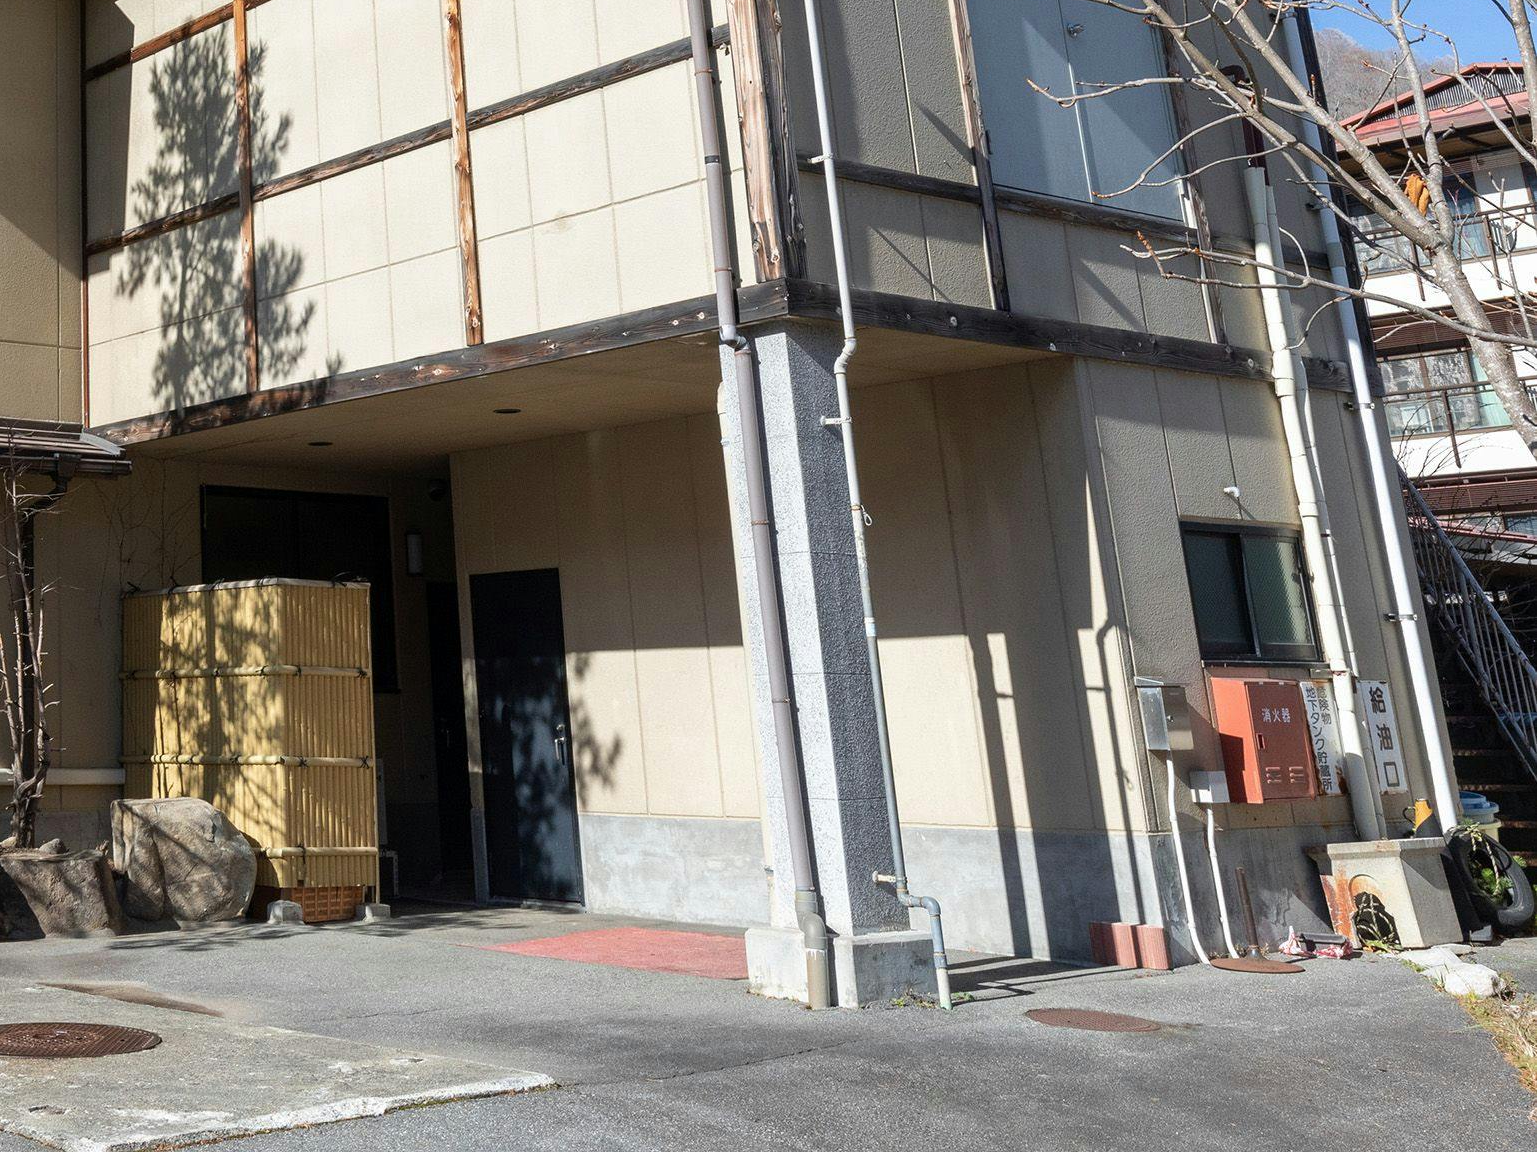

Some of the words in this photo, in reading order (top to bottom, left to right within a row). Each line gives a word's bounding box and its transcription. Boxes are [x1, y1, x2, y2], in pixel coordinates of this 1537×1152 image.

[1262, 707, 1291, 723] 消火器
[1369, 686, 1400, 787] 給油口
